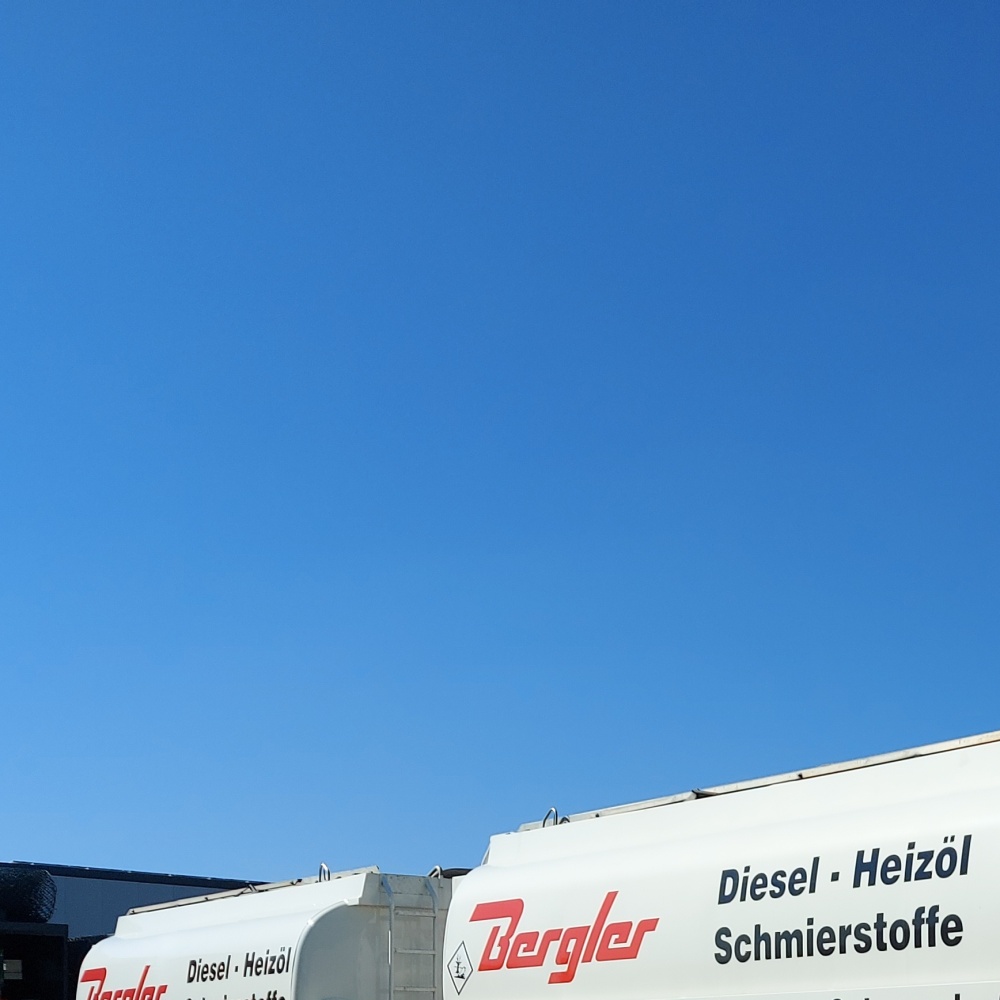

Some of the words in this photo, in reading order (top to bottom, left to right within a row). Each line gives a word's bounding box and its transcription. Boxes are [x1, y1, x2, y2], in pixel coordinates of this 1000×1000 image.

[717, 856, 820, 905] Diesel
[852, 834, 972, 888] Heizöl
[187, 955, 231, 983] Diesel
[243, 947, 292, 977] Heizöl
[469, 890, 660, 984] Bergler
[714, 904, 963, 965] Schmierstoffe
